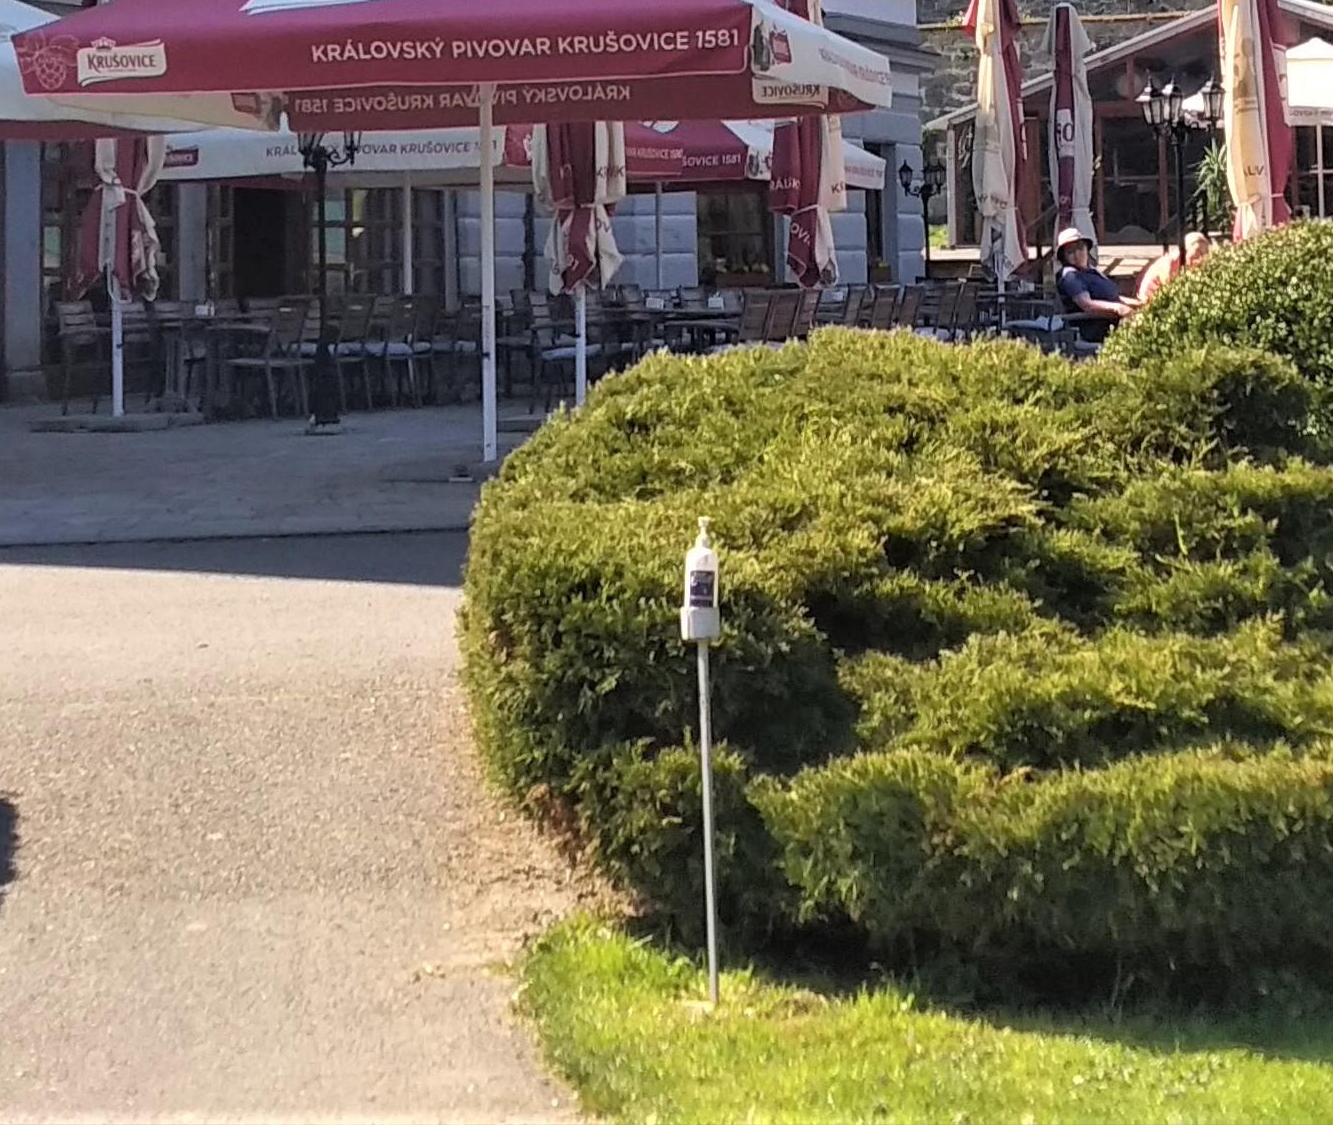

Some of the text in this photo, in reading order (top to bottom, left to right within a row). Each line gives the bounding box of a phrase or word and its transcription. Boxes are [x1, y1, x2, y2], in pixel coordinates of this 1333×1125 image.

[310, 28, 740, 63] KRÁLOVSKÝ PIVOVAR KRUŠOVICE 1581
[86, 52, 157, 74] KRUŠOVICE
[400, 140, 470, 155] KRUŠOVICE
